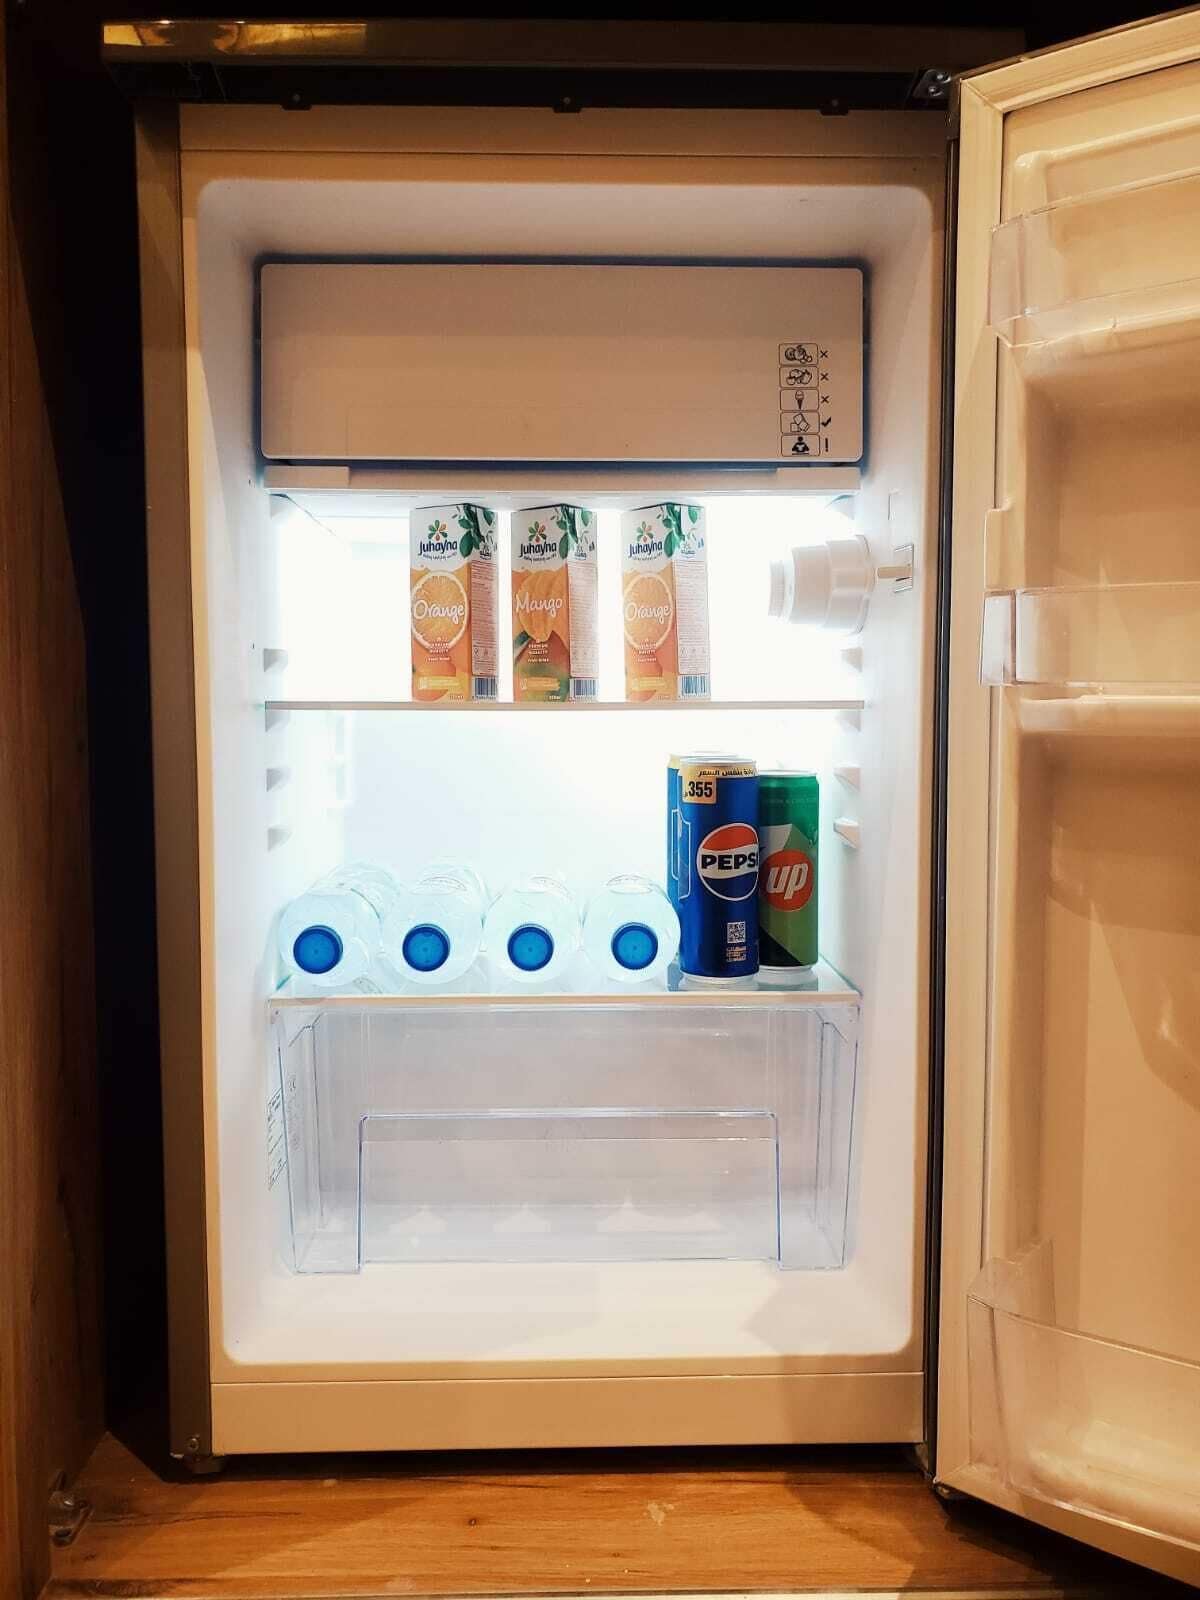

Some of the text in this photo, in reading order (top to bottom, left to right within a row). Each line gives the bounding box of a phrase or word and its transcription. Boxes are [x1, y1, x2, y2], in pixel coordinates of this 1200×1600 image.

[418, 540, 458, 556] Juhayna
[518, 541, 557, 558] Juhayna
[628, 540, 663, 558] Juhayna
[413, 599, 465, 625] Orange
[515, 592, 563, 618] Mango
[625, 602, 672, 625] Orange
[688, 781, 713, 798] 355
